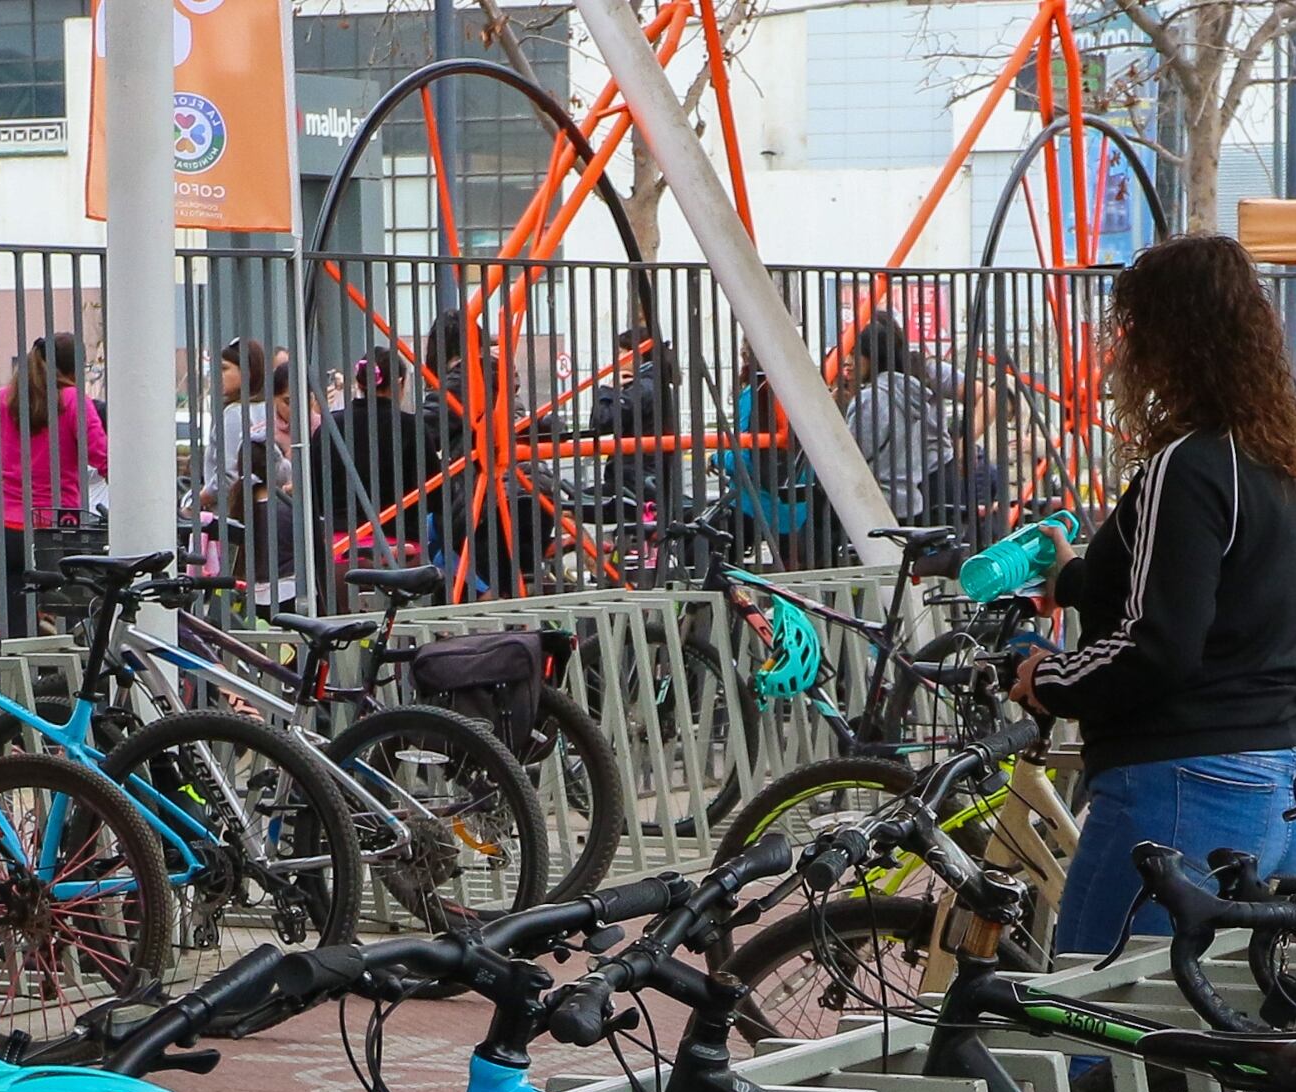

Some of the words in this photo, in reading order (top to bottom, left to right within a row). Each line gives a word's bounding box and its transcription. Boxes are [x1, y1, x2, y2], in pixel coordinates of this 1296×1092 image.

[305, 108, 378, 146] mallpla
[151, 693, 246, 834] RKRIDER
[1061, 1010, 1107, 1036] 3500
